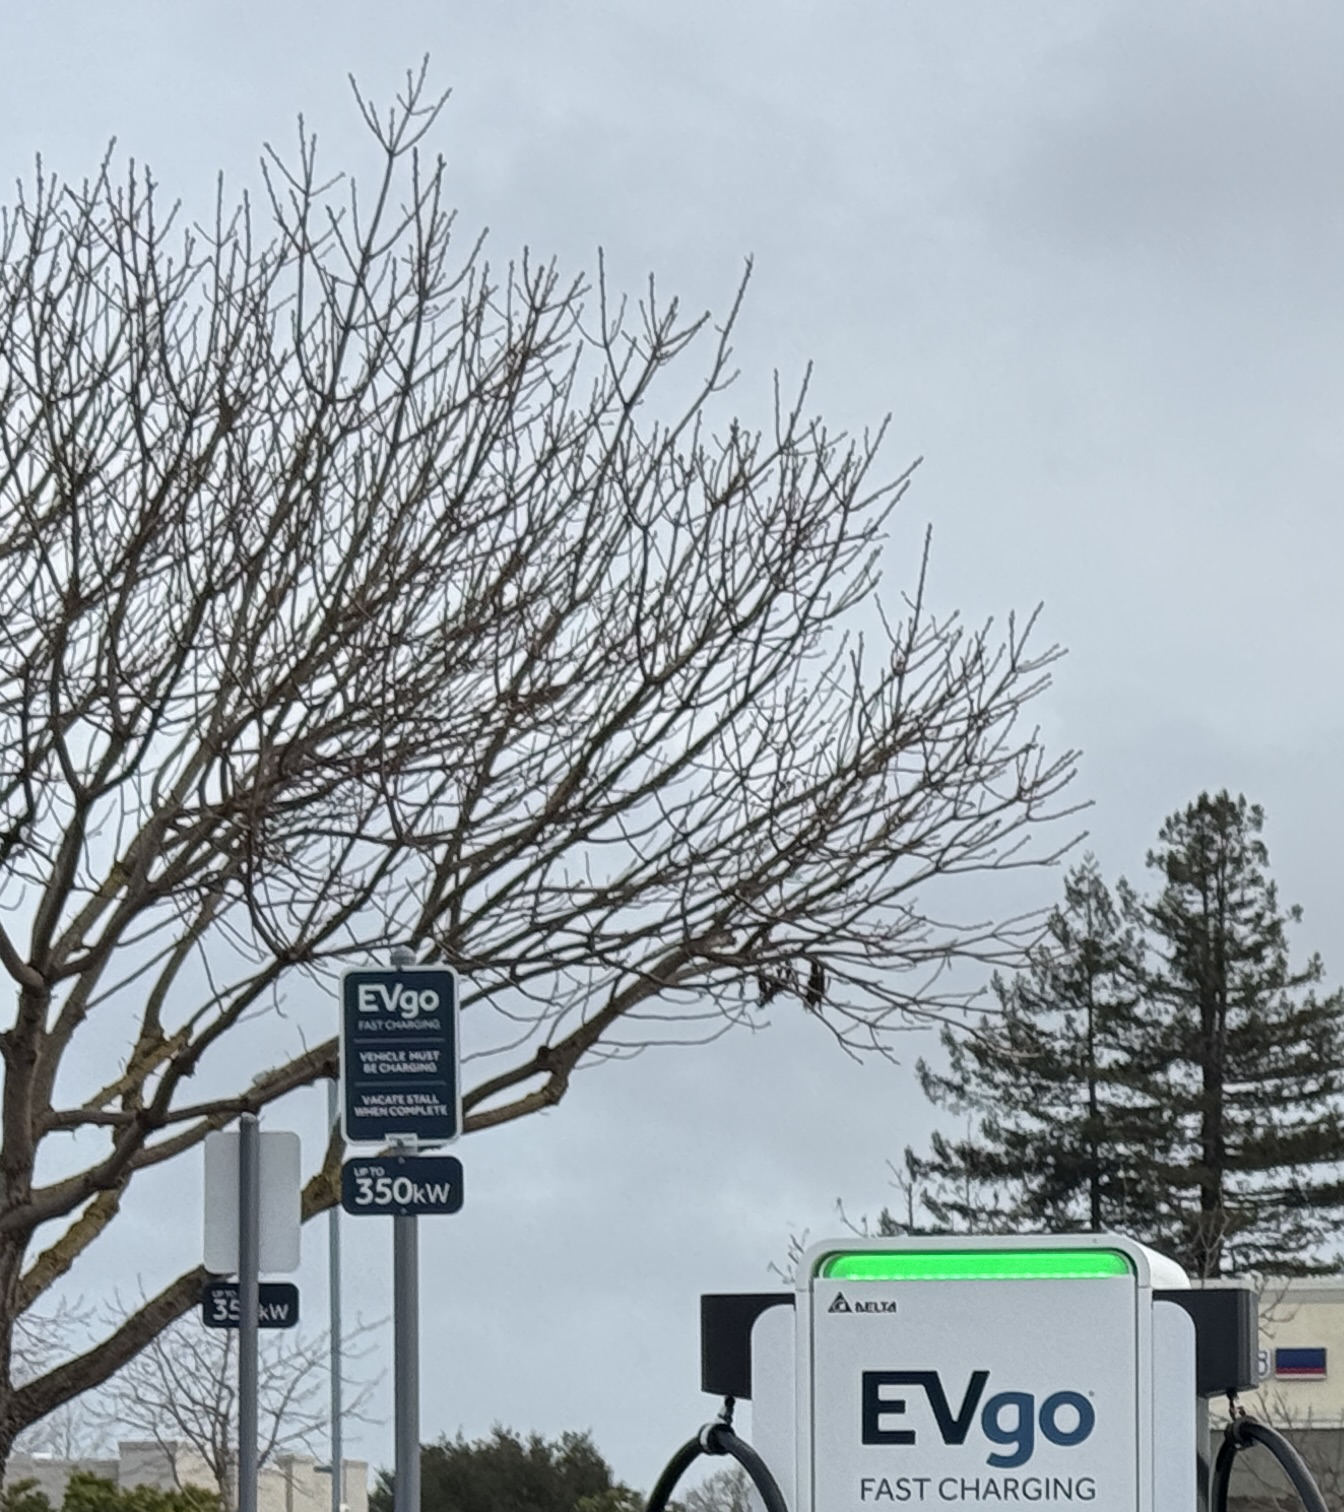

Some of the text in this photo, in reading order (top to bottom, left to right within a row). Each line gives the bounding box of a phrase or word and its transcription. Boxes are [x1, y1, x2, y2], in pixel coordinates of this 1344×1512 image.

[358, 983, 440, 1019] EVgo
[358, 1019, 441, 1031] FAST CHARGING
[359, 1050, 440, 1062] VEHICLE MUST
[363, 1062, 437, 1074] BE CHARGING
[361, 1094, 440, 1105] VACATE STALL
[353, 1105, 448, 1117] WHEN COMPLETE
[353, 1166, 385, 1177] UP TO
[355, 1177, 450, 1205] 350kW
[213, 1299, 289, 1320] 35kW
[861, 1369, 1096, 1469] EVgo
[860, 1477, 1096, 1501] FAST CHARGING
